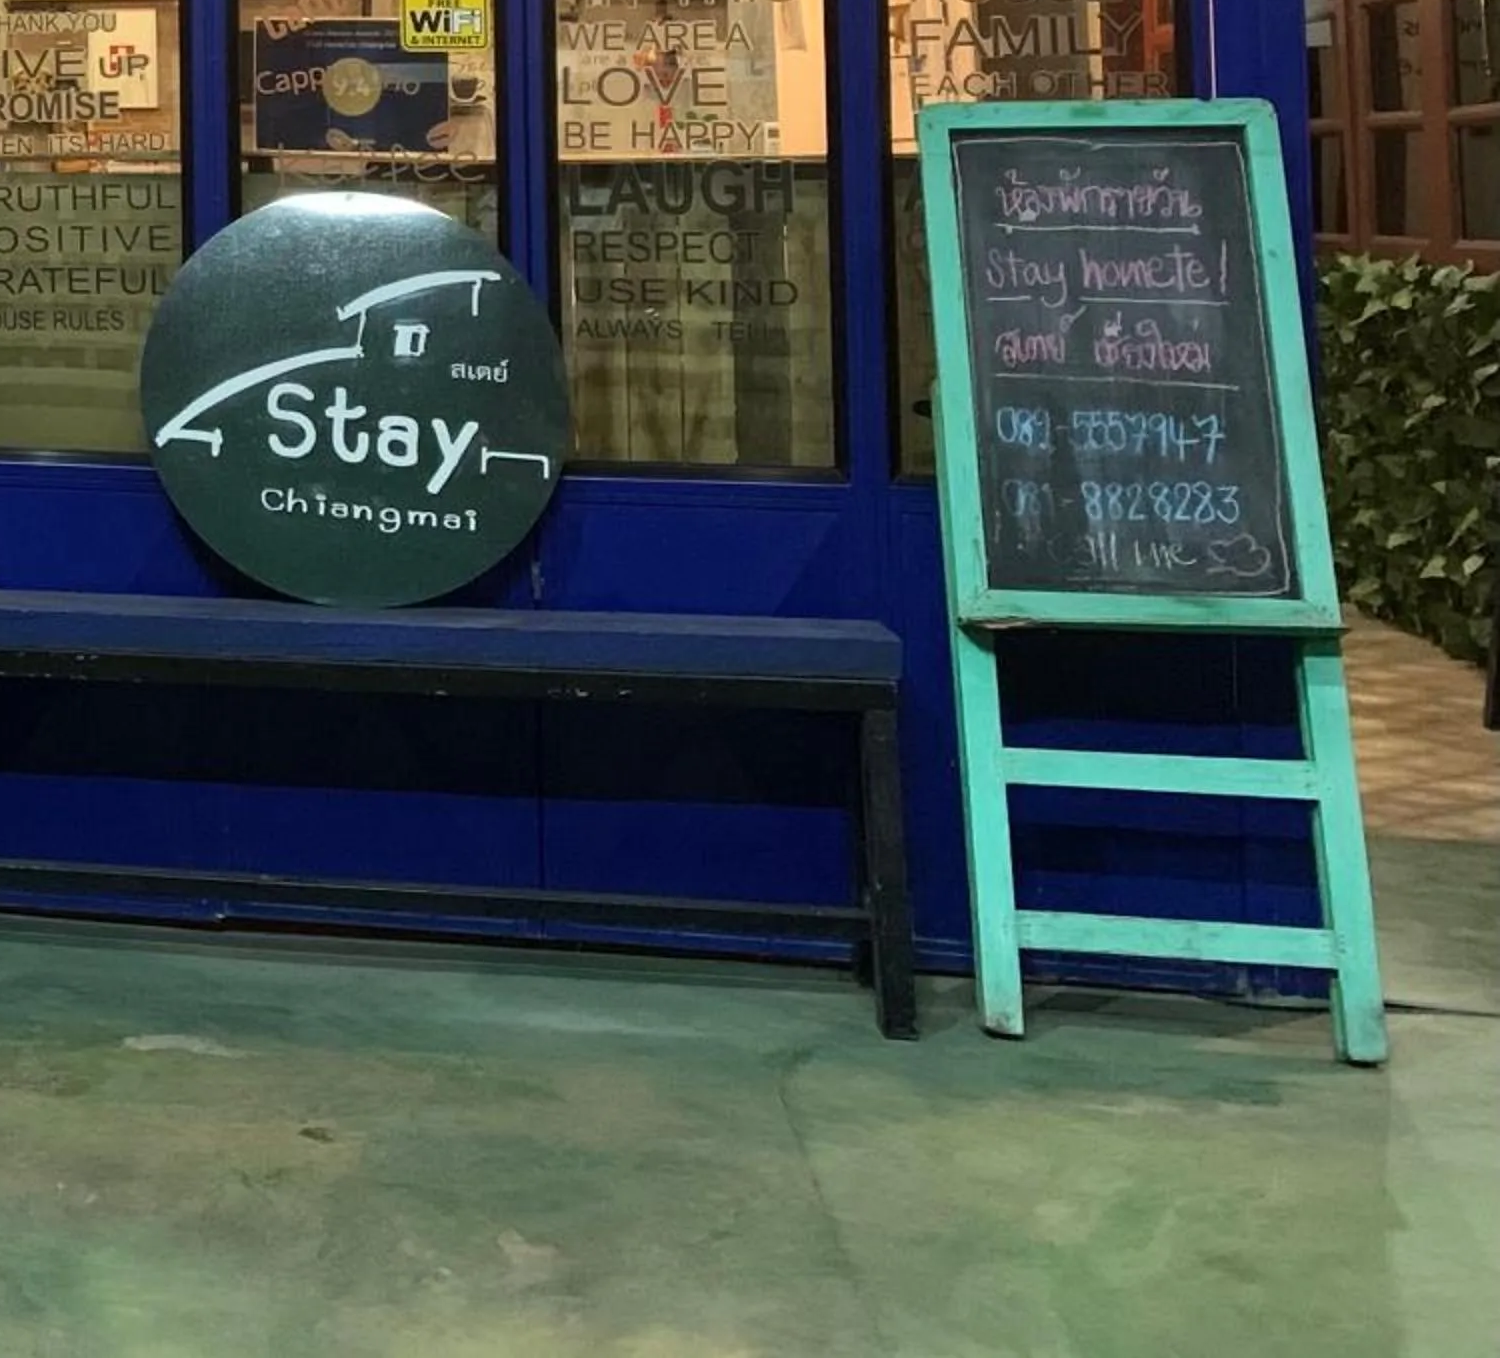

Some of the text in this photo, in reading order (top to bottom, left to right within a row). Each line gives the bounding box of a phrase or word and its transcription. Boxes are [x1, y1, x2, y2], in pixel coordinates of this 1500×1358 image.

[65, 12, 117, 33] YOU
[409, 9, 483, 34] WiFi
[564, 21, 752, 50] WE ARE A
[910, 13, 1144, 57] FAMILY
[421, 35, 481, 46] INTERNET
[99, 52, 150, 79] UP
[561, 66, 728, 107] LOVE
[911, 71, 1171, 98] EACH OTHER
[100, 132, 166, 152] HARD
[564, 121, 760, 151] BE HAPPY
[568, 160, 794, 216] LAUGH
[573, 231, 761, 264] RESPECT
[576, 278, 799, 306] USE KIND
[986, 247, 1069, 309] Stay
[53, 310, 125, 331] RULES
[577, 319, 683, 340] ALWAYS
[266, 383, 479, 495] Stay
[260, 489, 479, 534] Chiangmai
